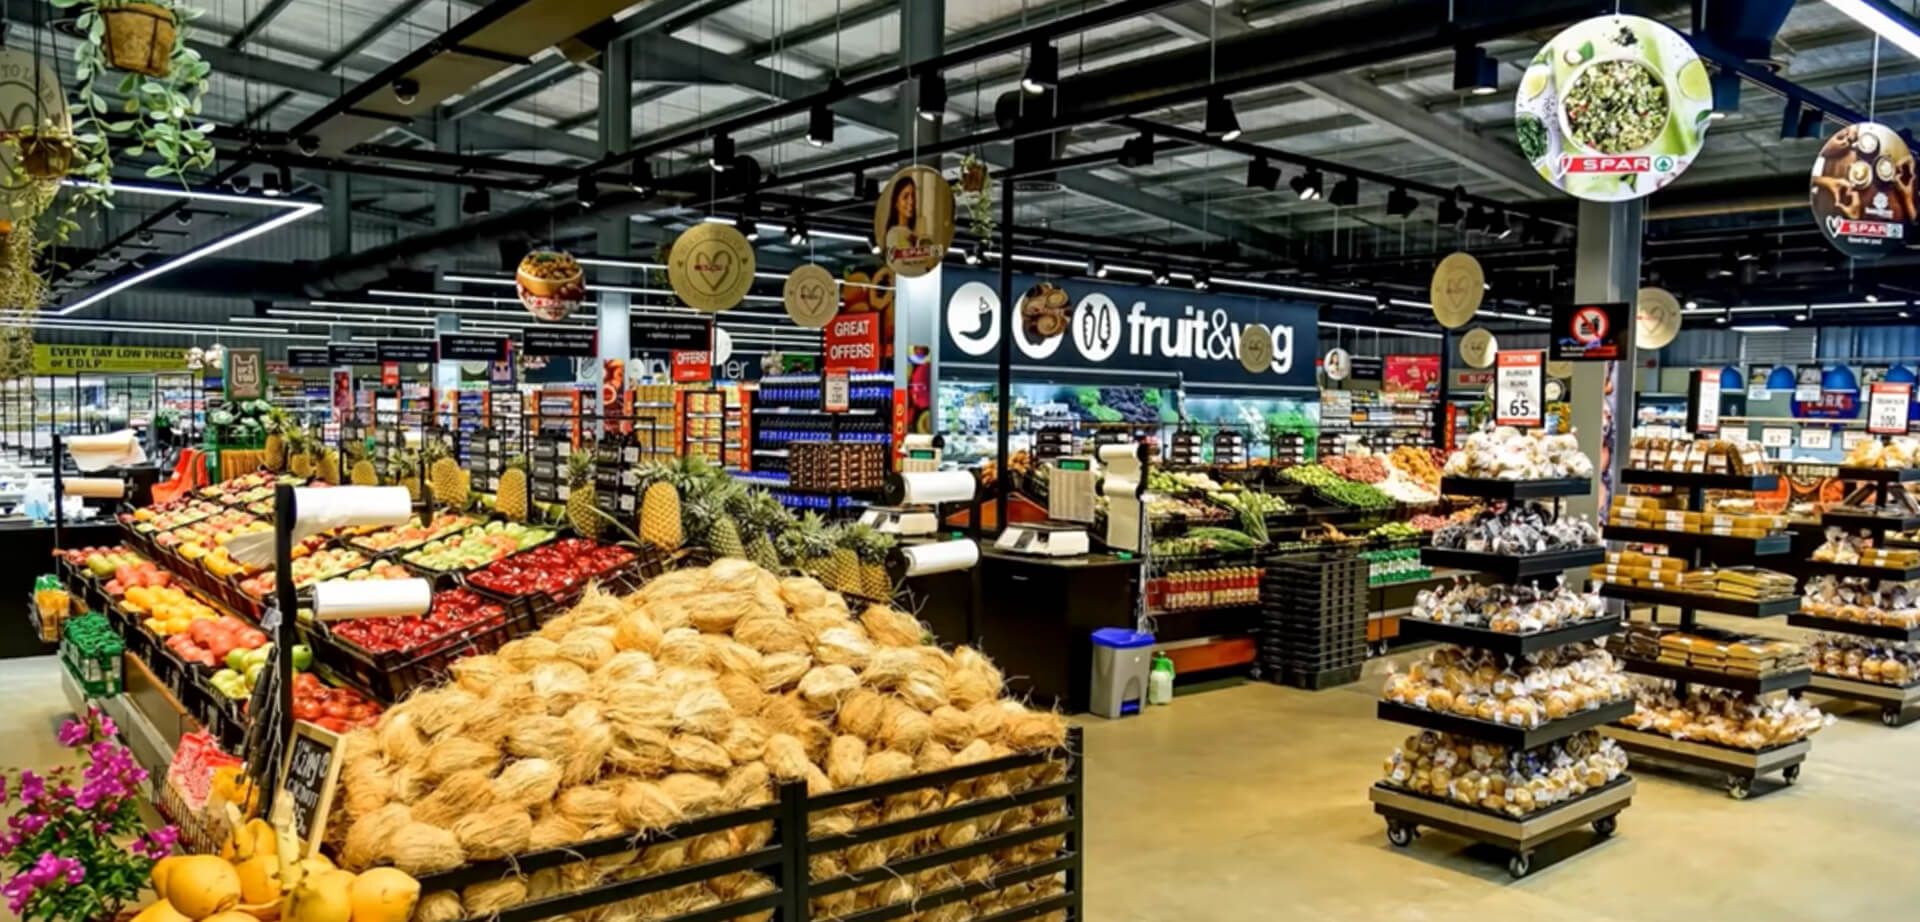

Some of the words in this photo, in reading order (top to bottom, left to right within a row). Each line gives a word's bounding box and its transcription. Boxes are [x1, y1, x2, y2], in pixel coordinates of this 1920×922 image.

[1, 63, 20, 77] TO
[1582, 158, 1649, 170] SPAR
[1849, 223, 1886, 235] SPAR
[834, 320, 870, 337] GREAT
[50, 347, 87, 358] EVERY
[91, 348, 113, 358] DAY
[116, 350, 141, 358] LOW
[145, 350, 185, 360] PRICES
[830, 343, 874, 360] OFFERS!
[51, 359, 63, 368] or
[67, 359, 102, 368] EDLP
[1510, 400, 1529, 416] 65
